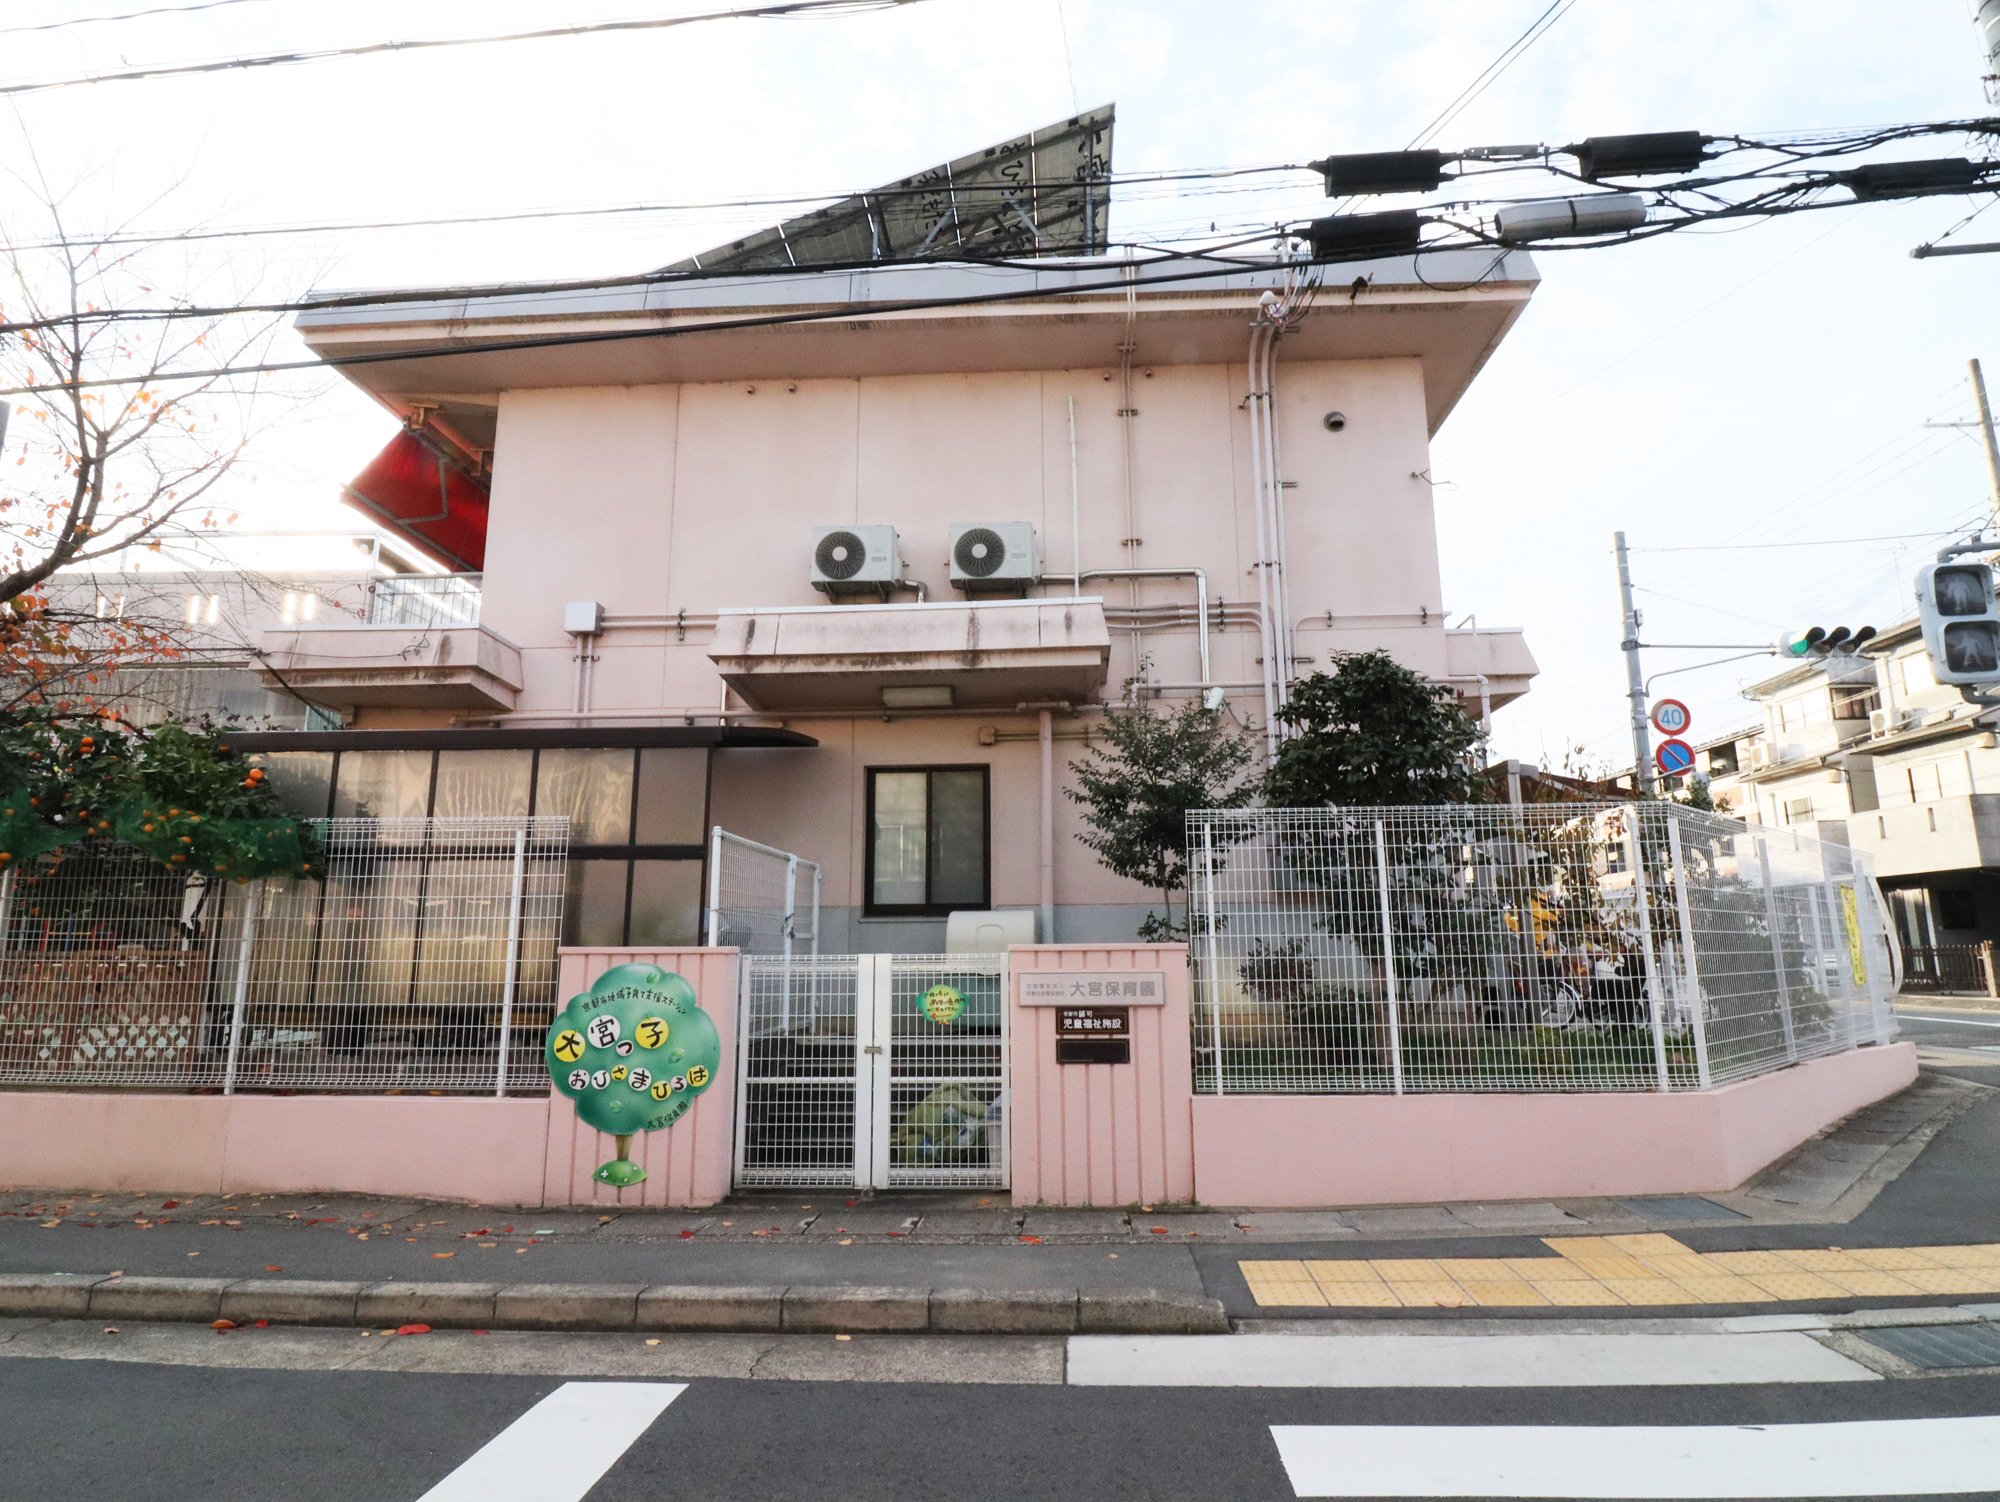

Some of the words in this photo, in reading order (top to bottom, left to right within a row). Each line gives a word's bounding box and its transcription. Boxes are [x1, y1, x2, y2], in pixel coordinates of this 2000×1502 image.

[1661, 709, 1682, 725] 40
[1070, 981, 1155, 997] 大宮保育園
[581, 986, 687, 1015] 京都市地域子育て支援ステーション
[1063, 1018, 1122, 1029] 児童福祉施設
[555, 1018, 665, 1059] 大宮っ子
[570, 1066, 708, 1101] おひさまひろば
